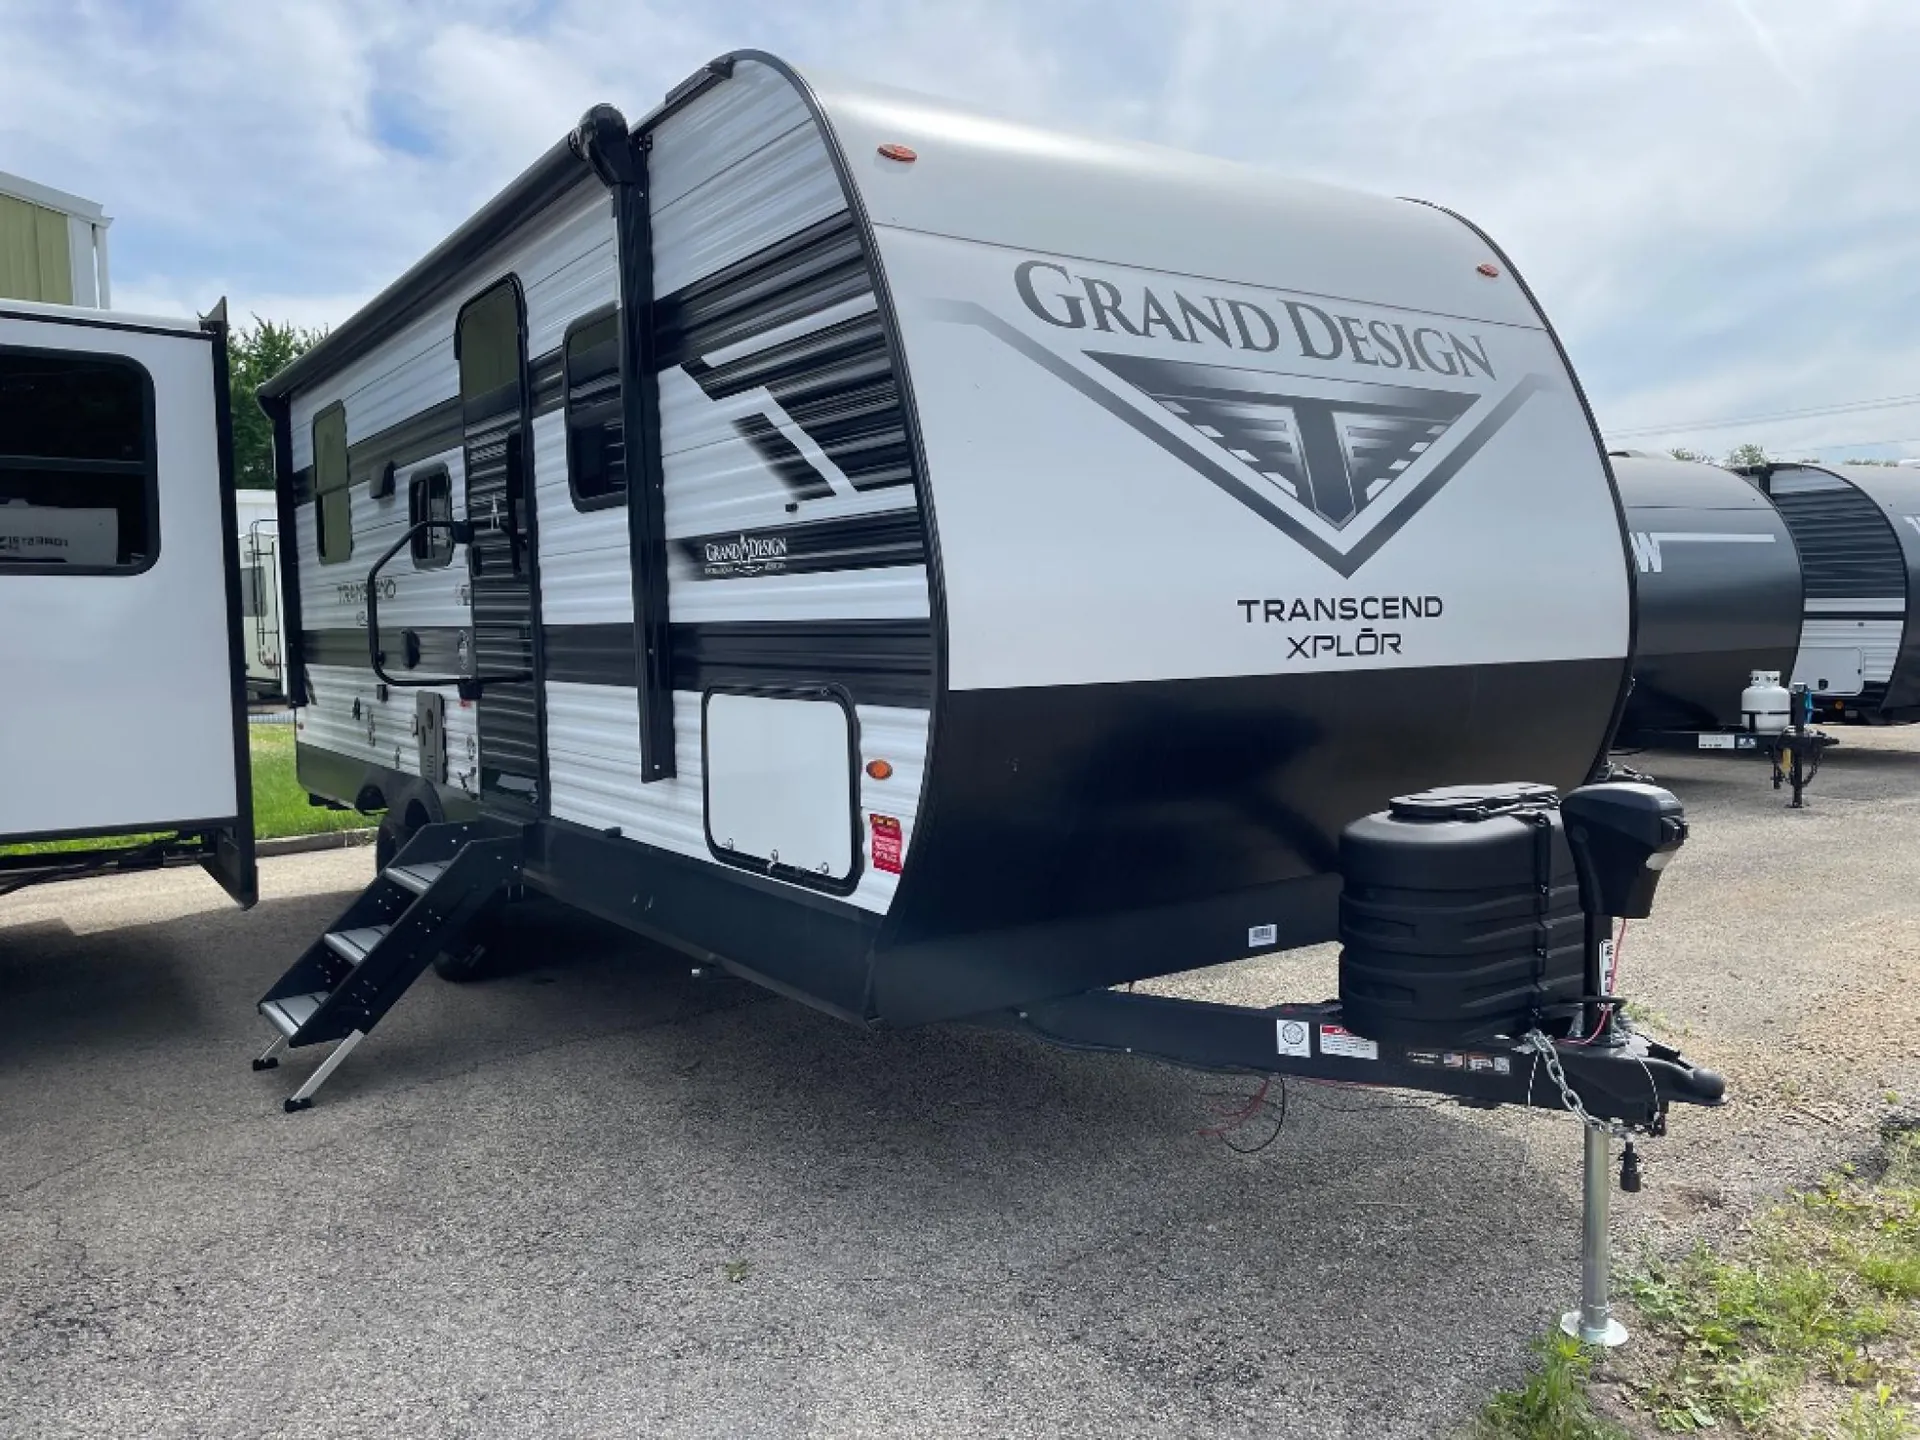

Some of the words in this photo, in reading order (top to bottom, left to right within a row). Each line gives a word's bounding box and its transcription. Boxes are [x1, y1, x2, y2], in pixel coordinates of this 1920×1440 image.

[1013, 260, 1280, 352] GRAND
[1278, 299, 1496, 381] DESIGN
[704, 543, 741, 562] GRAND
[747, 536, 787, 559] DESIGN
[337, 578, 397, 604] TRANSEND
[1237, 596, 1444, 624] TRANSCEND
